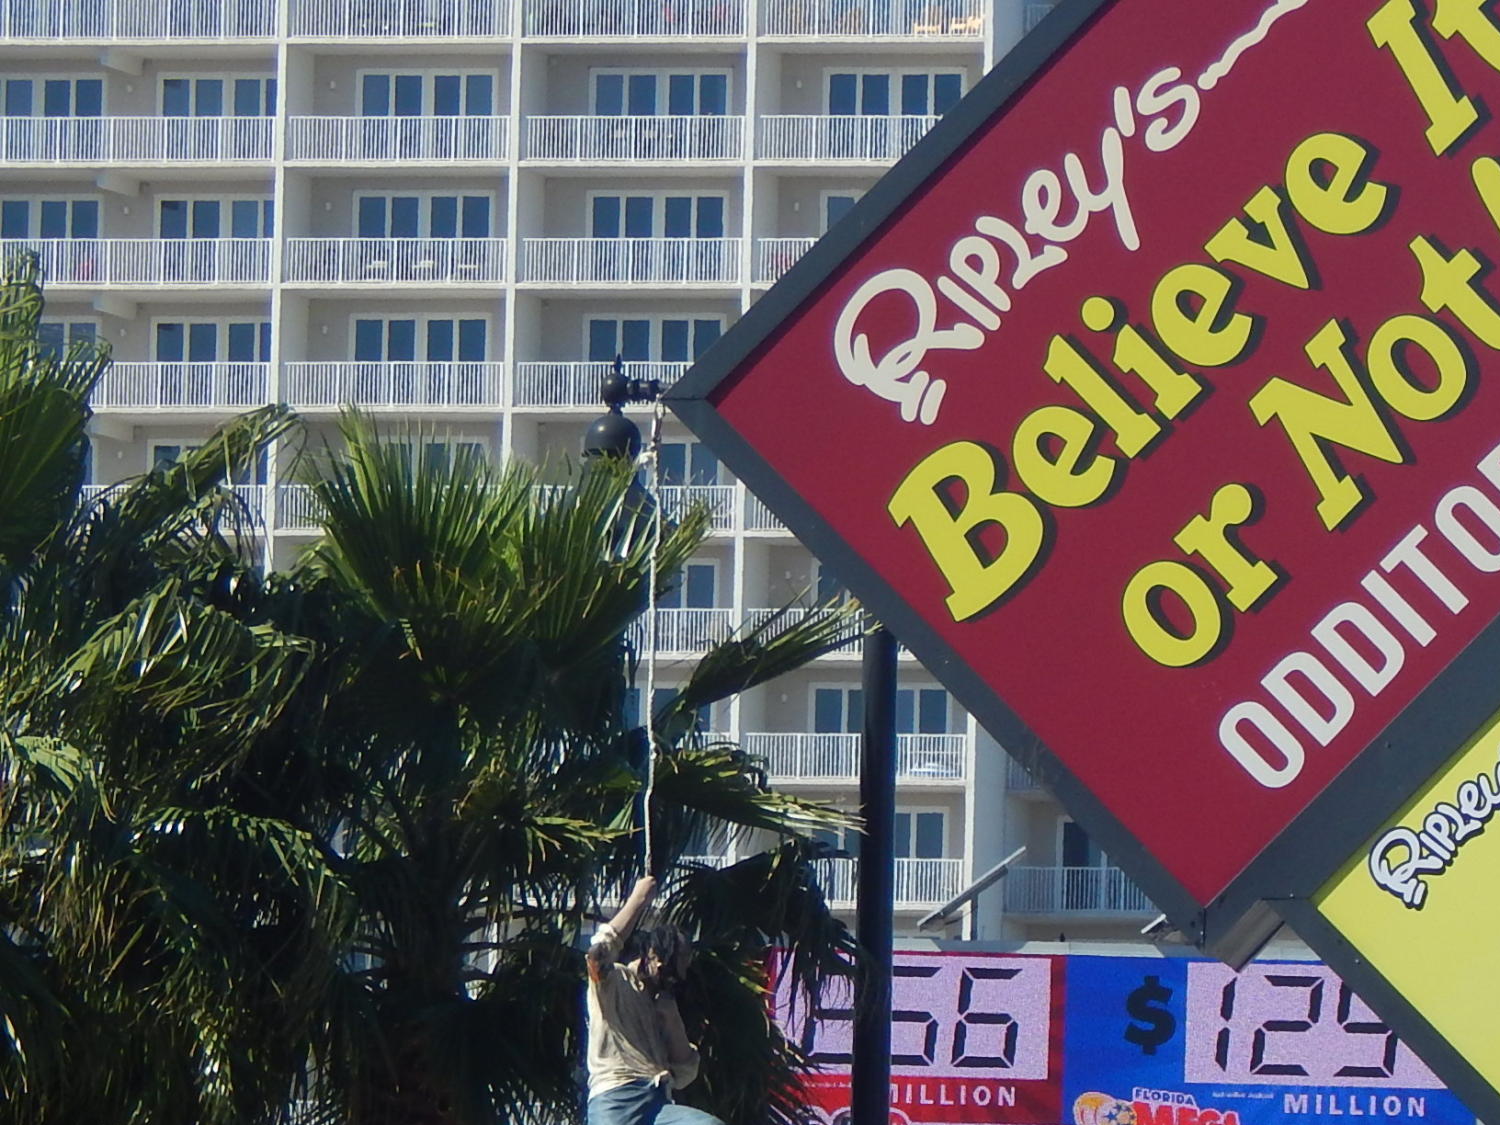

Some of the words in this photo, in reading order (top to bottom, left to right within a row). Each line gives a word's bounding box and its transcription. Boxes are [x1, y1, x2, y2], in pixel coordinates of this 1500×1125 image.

[888, 132, 1388, 623] Believe
[1122, 483, 1279, 667] or
[1123, 975, 1177, 1056] $
[1214, 974, 1398, 1078] 125
[1135, 1089, 1194, 1106] FLORIDA
[1284, 1094, 1426, 1118] MILLION
